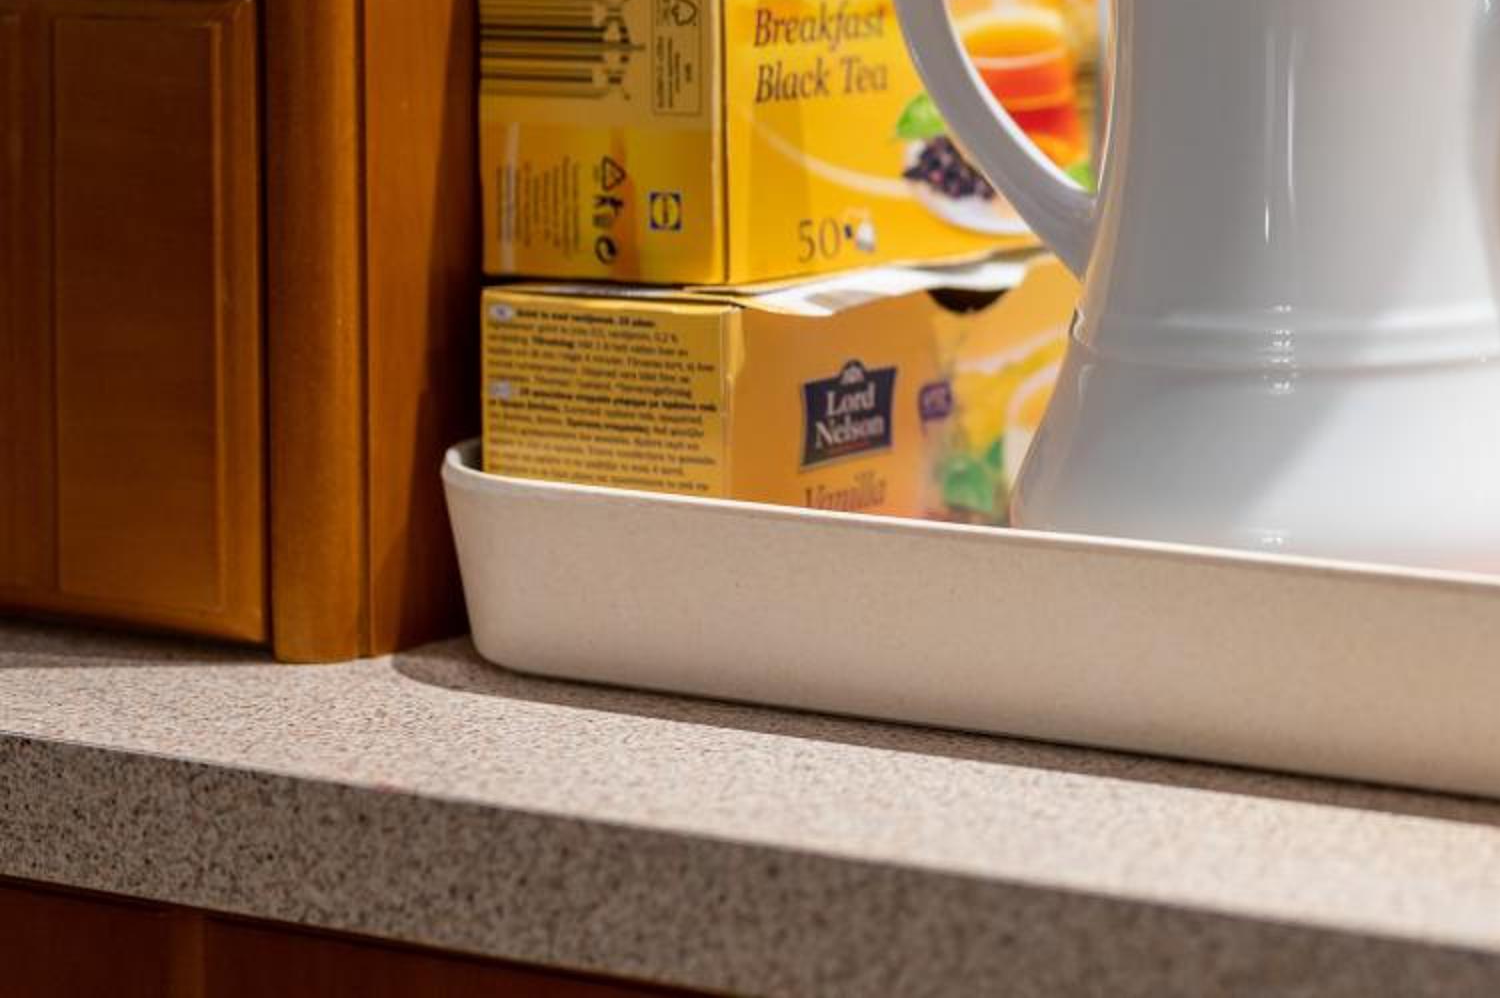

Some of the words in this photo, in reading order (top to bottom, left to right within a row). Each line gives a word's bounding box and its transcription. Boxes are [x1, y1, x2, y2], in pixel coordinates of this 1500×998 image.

[753, 0, 886, 51] Breakfast
[754, 56, 831, 105] Black
[840, 53, 888, 97] Tea
[797, 217, 841, 264] 50
[826, 381, 876, 417] Lord
[815, 414, 885, 450] Nelson
